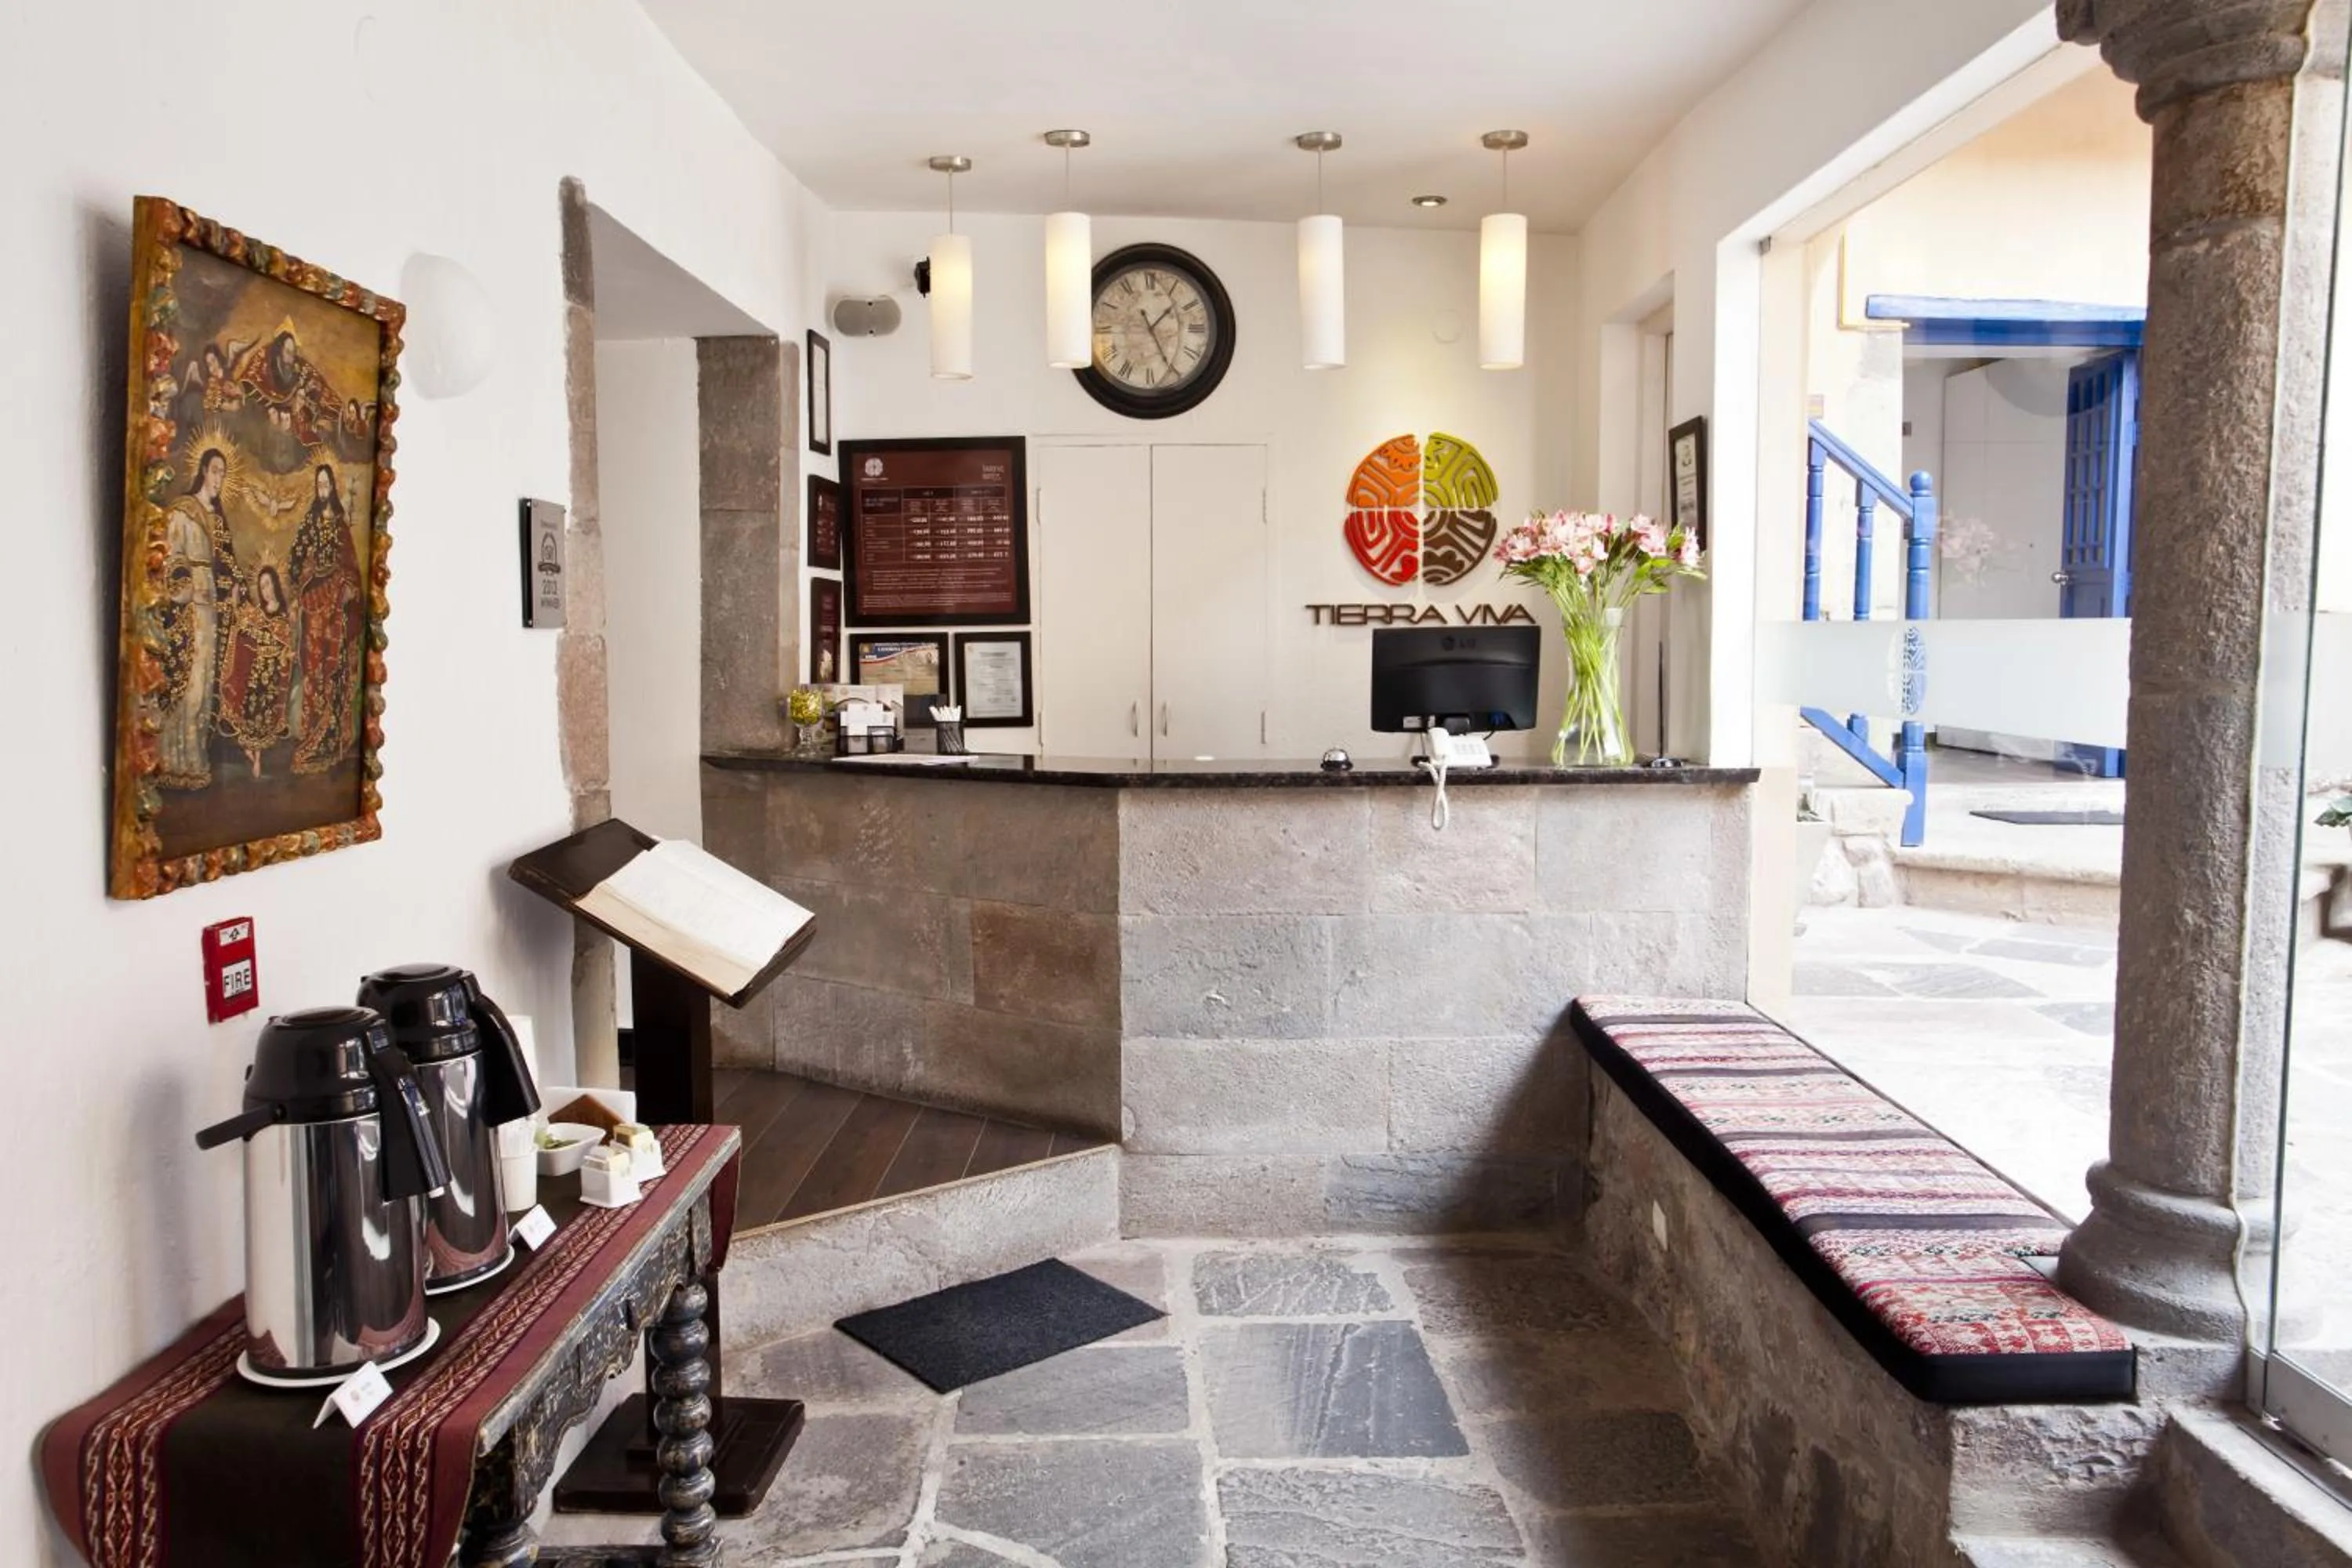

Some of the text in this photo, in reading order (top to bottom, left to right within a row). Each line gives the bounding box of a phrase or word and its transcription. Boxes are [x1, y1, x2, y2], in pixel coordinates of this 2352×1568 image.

[1305, 603, 1537, 626] TIERRA VIVA
[223, 968, 252, 993] FIRE
